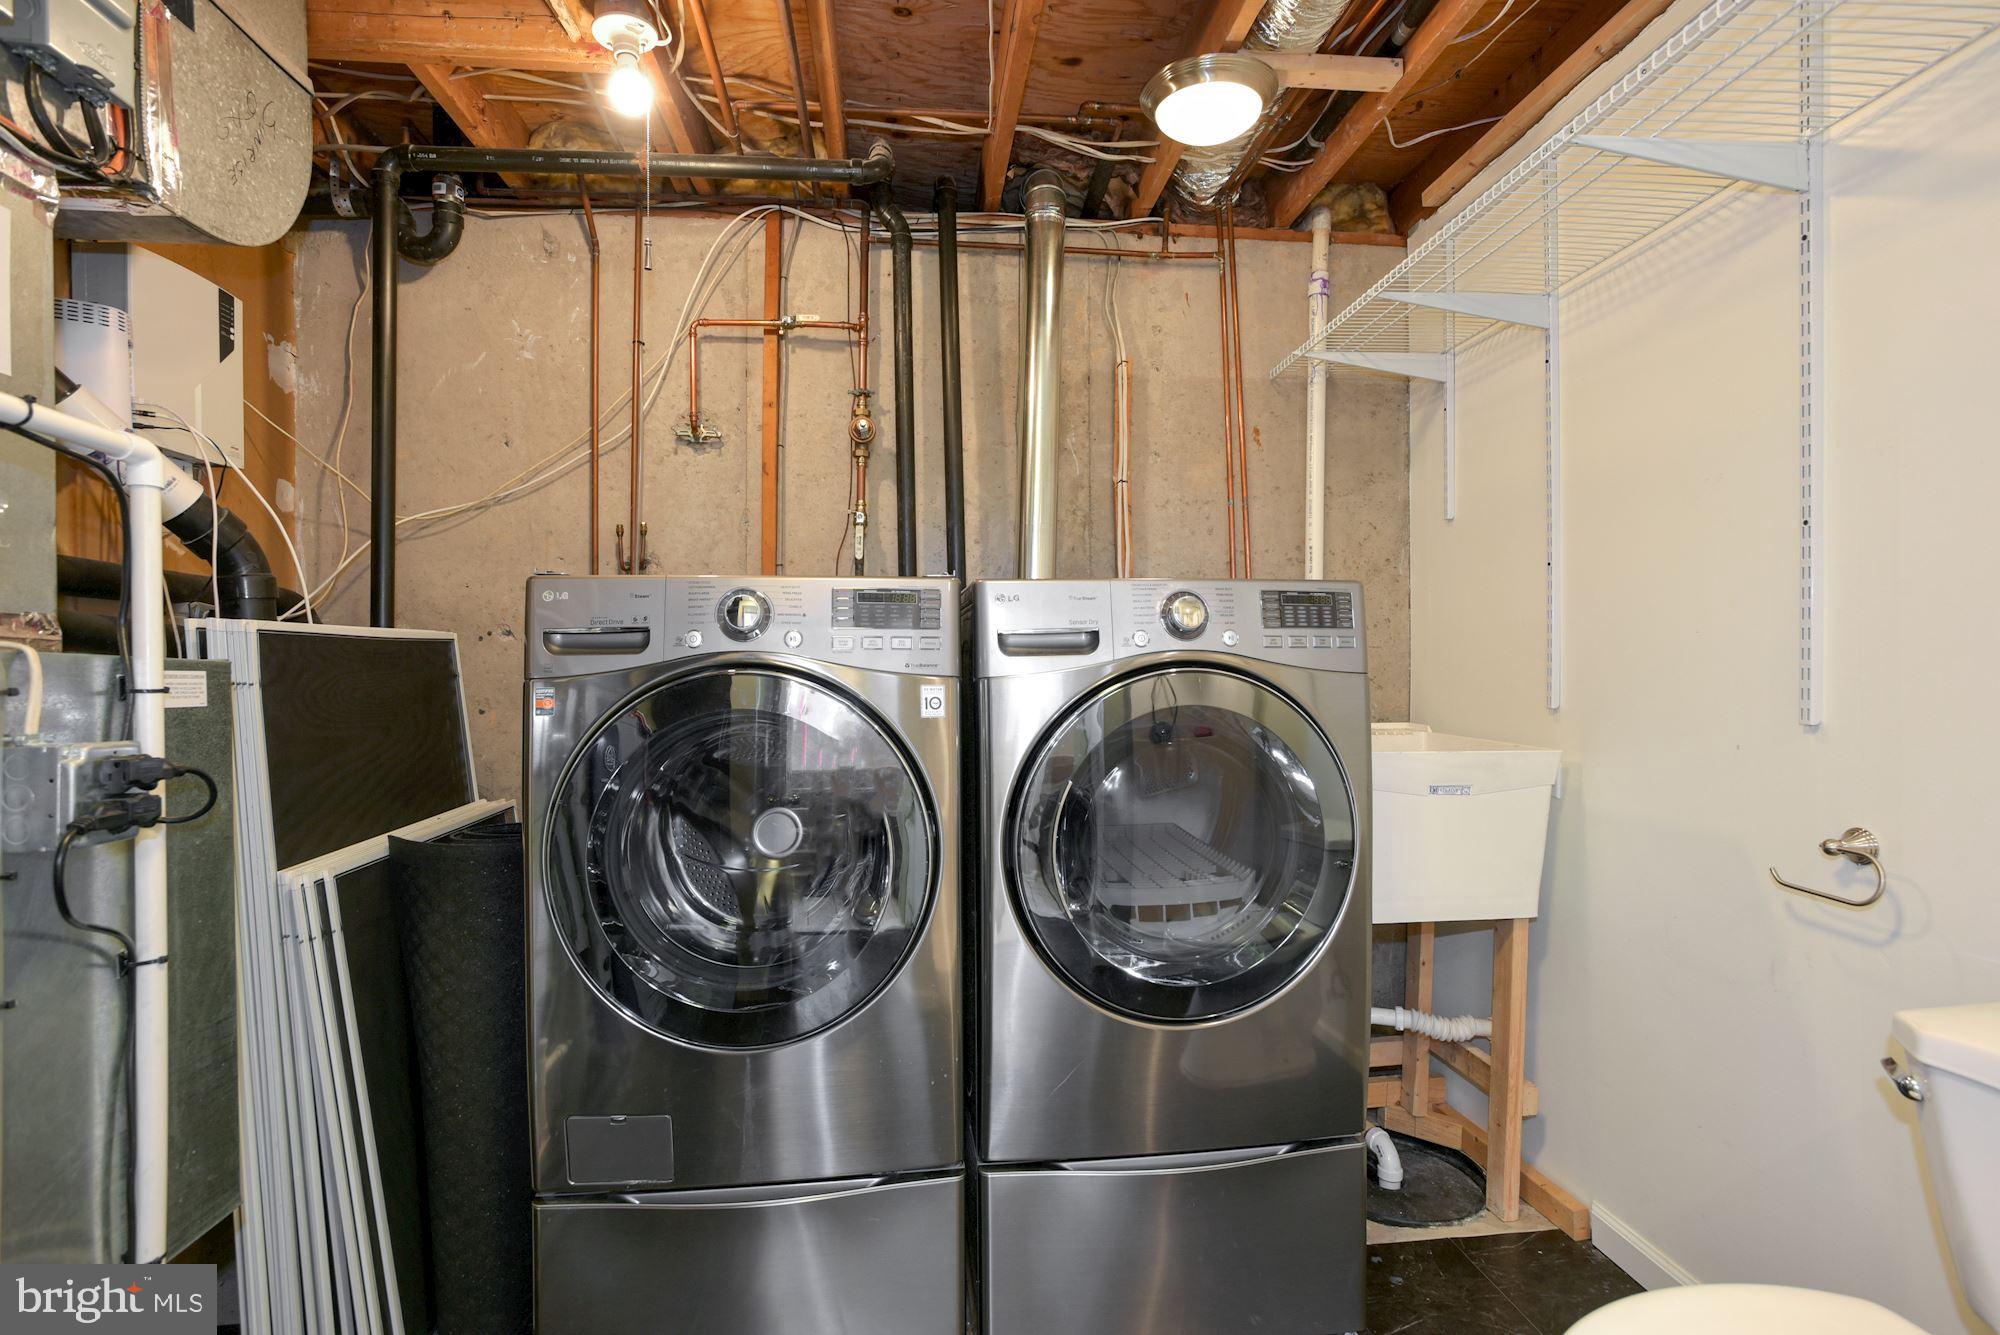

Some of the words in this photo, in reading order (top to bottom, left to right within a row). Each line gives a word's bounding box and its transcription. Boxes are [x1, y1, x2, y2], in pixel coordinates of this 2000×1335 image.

[556, 591, 569, 600] LG
[1008, 594, 1020, 602] LG
[924, 696, 942, 710] 10
